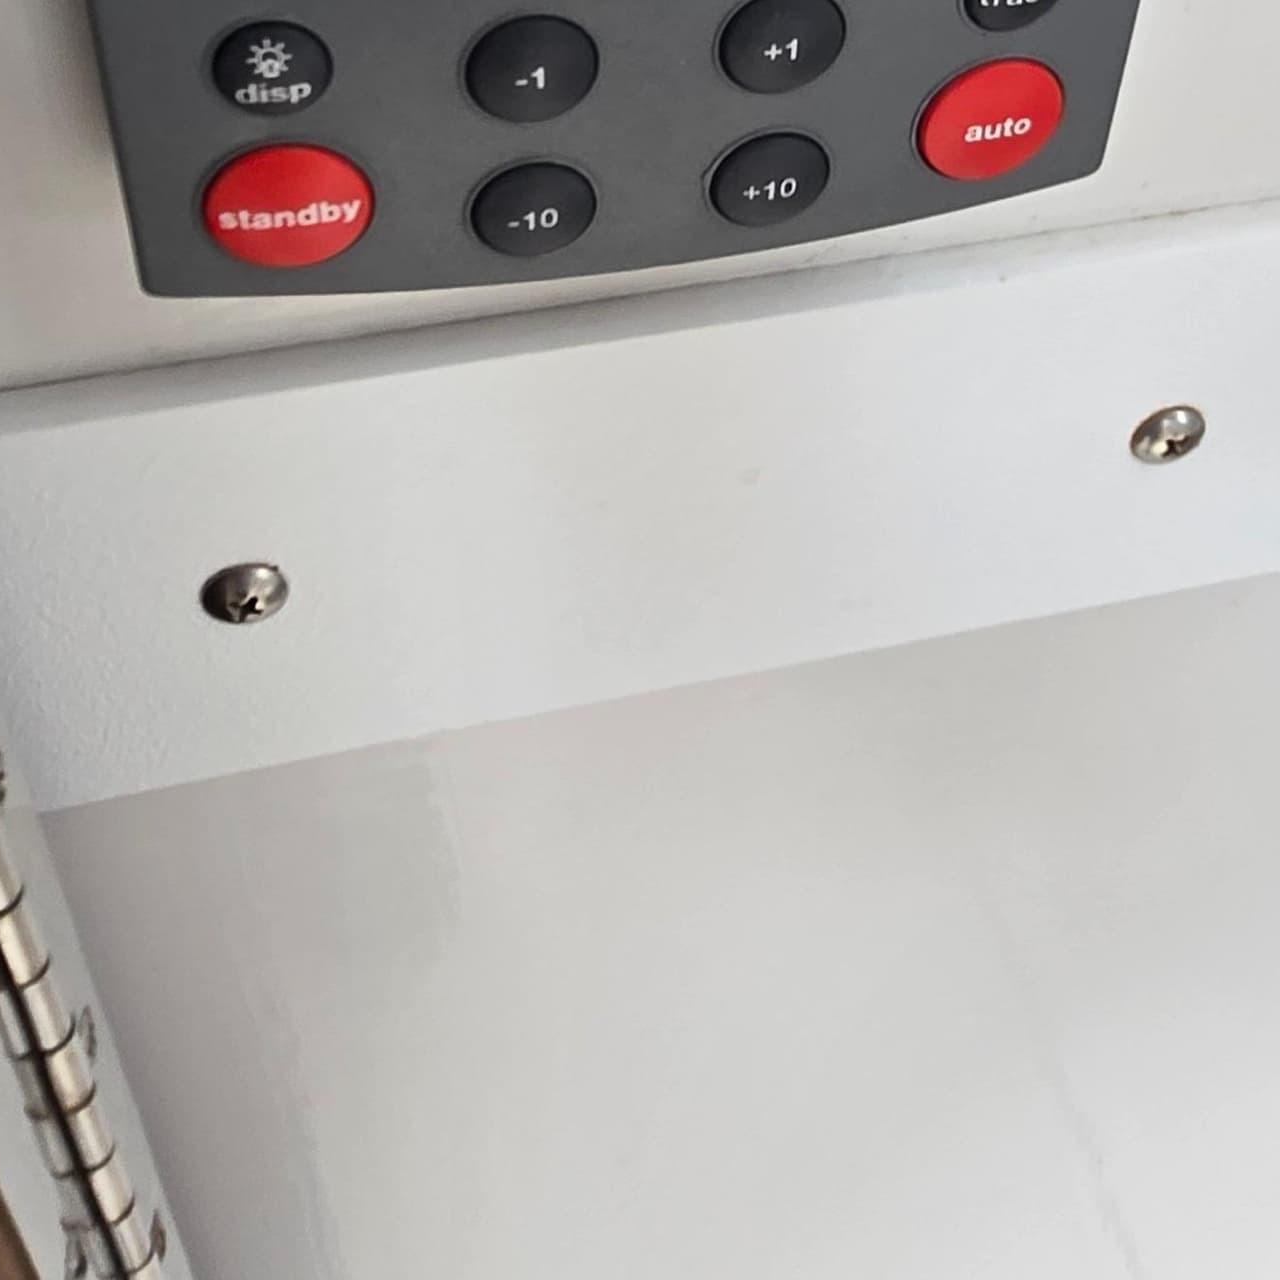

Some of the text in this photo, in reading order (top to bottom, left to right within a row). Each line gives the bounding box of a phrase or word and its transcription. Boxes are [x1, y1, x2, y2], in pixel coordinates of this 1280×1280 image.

[763, 38, 801, 62] +1
[514, 66, 548, 90] -1
[234, 81, 313, 104] disp
[963, 117, 1033, 144] auto
[742, 176, 798, 202] +10
[217, 198, 362, 232] standby
[507, 207, 560, 232] -10
